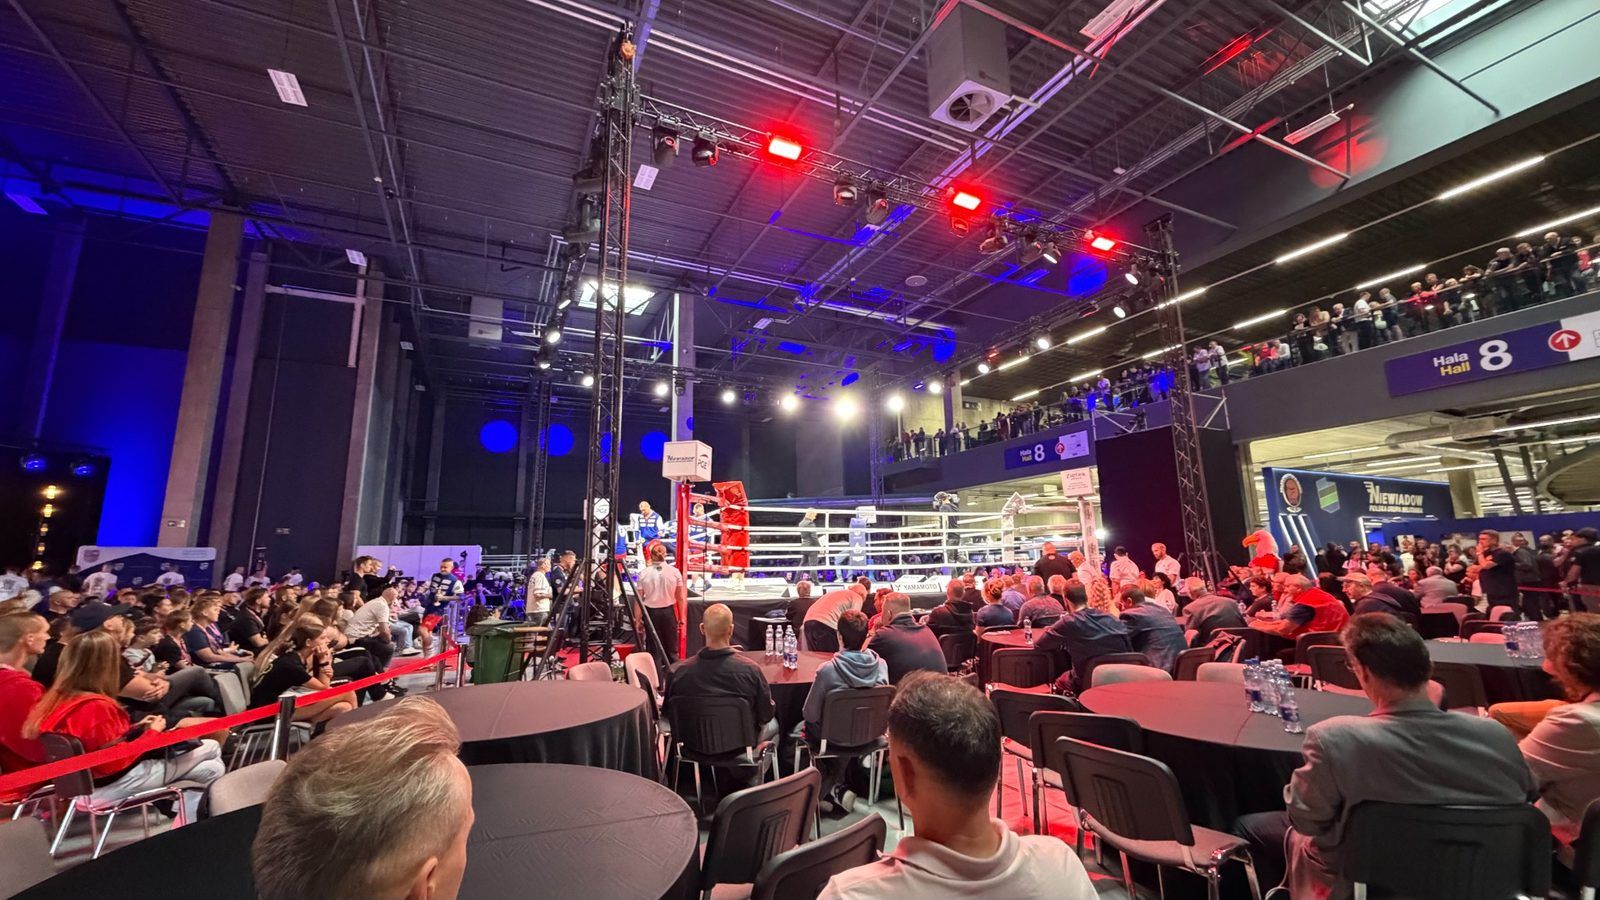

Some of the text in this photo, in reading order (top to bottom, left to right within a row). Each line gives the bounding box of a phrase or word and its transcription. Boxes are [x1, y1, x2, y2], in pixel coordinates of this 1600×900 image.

[1433, 352, 1469, 367] Hala
[1479, 339, 1513, 371] 8
[1440, 361, 1471, 376] Hall
[1034, 444, 1045, 462] 8
[903, 583, 938, 591] YAMAMOTO
